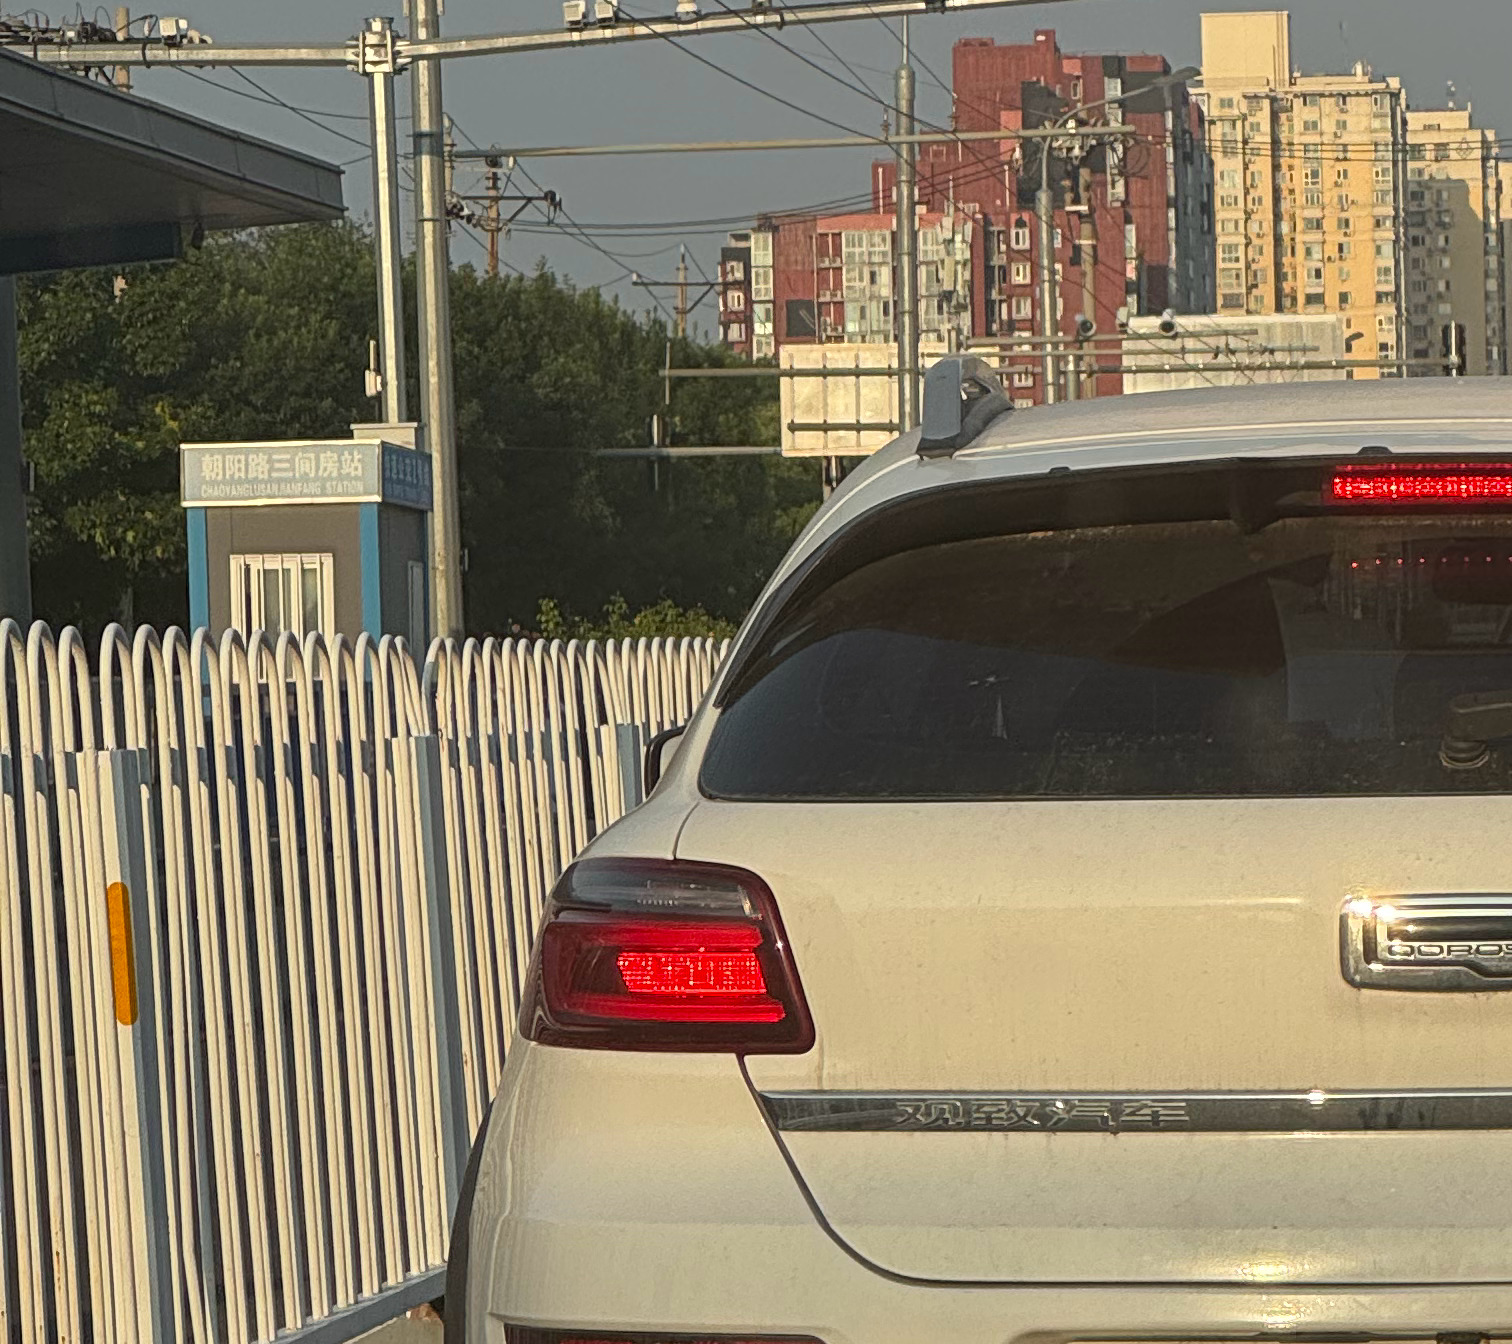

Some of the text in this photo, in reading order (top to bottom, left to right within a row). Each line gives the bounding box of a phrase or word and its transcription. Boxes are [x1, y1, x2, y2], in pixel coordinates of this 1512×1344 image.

[201, 450, 363, 481] 朝阳路三间房站
[326, 480, 364, 494] STATION
[896, 1100, 1190, 1127] 观致汽车
